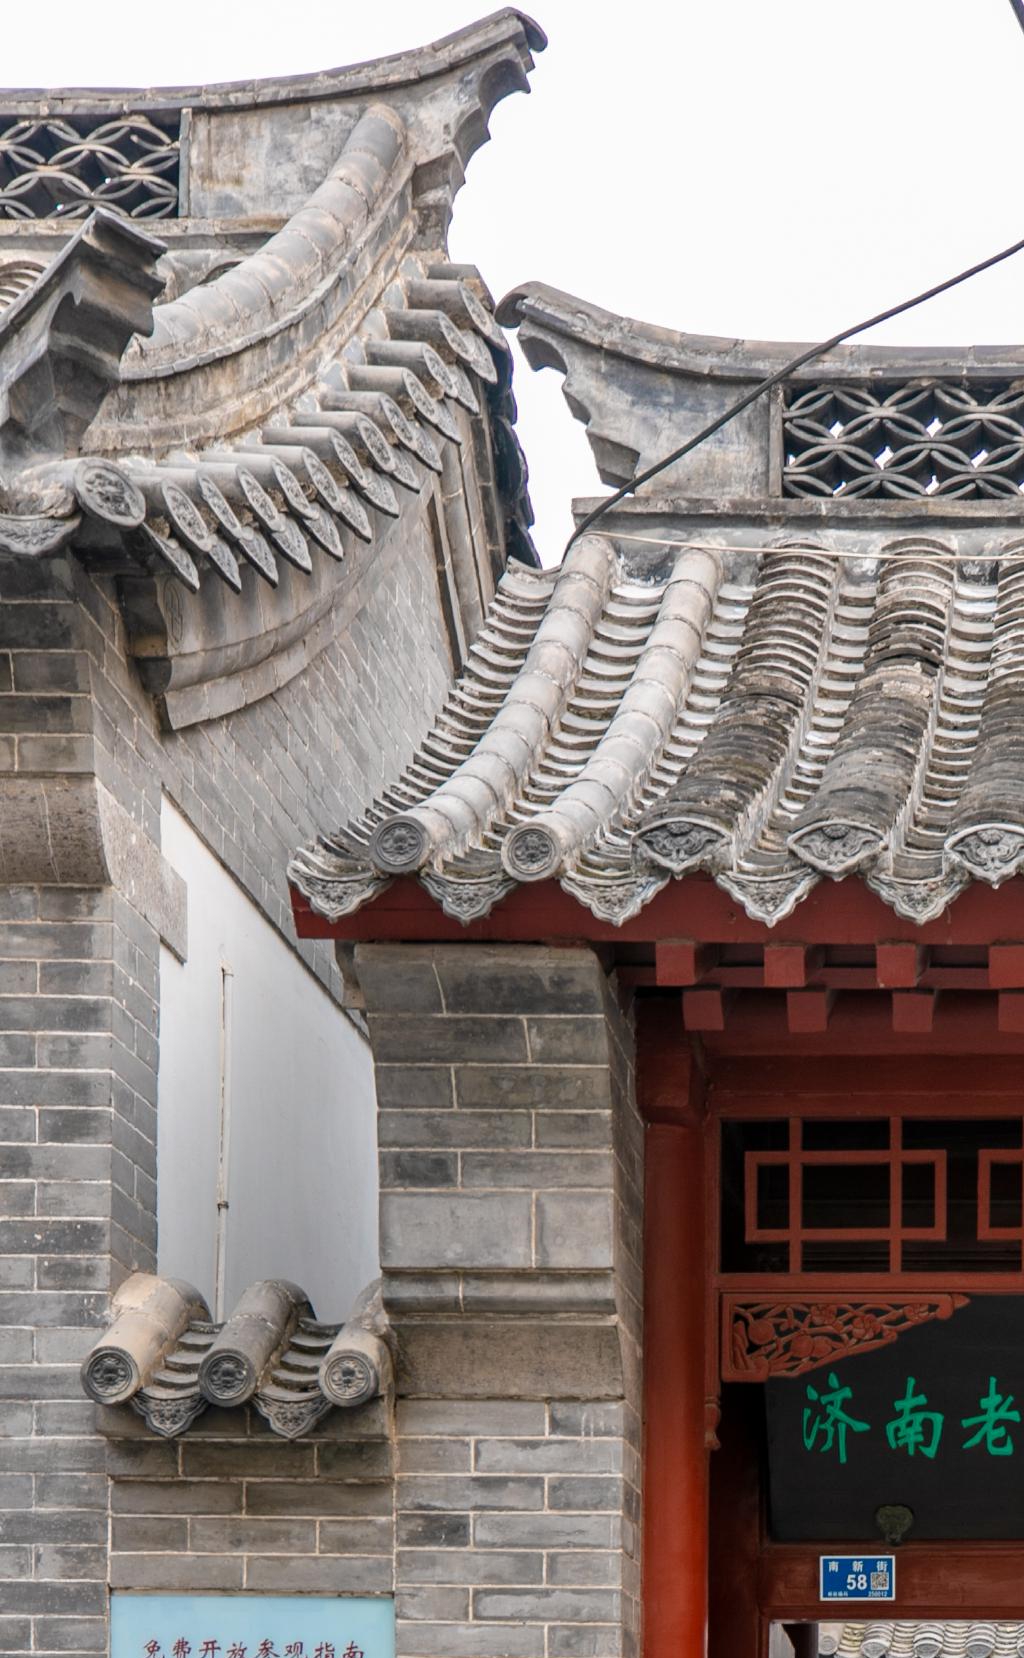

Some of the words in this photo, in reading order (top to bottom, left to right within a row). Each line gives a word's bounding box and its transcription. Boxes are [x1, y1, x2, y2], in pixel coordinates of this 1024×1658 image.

[828, 1561, 888, 1573] 南新街
[846, 1574, 868, 1590] 58
